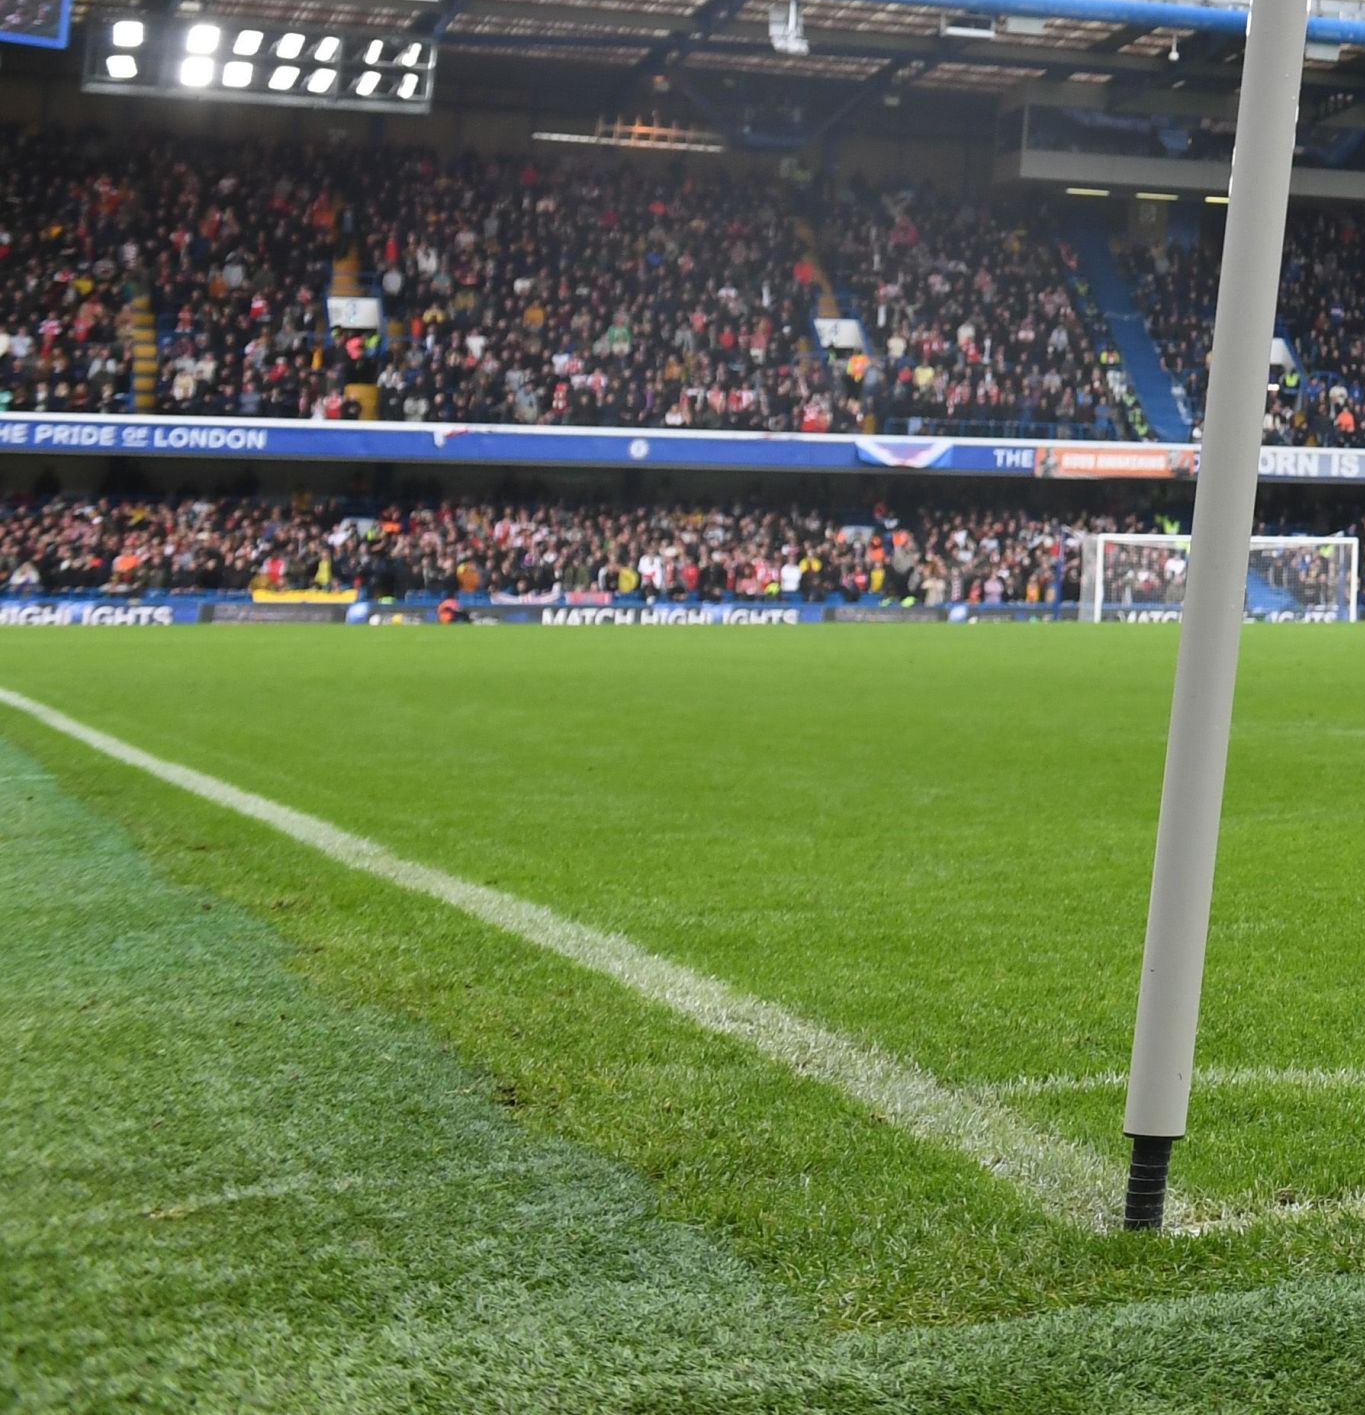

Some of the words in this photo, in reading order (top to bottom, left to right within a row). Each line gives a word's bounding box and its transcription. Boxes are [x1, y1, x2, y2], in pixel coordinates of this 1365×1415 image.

[34, 425, 117, 447] PRIDE
[121, 426, 149, 448] OF
[153, 427, 268, 449] LONDON
[993, 448, 1034, 468] THE
[1258, 452, 1318, 477] ORN
[1331, 454, 1359, 478] IS
